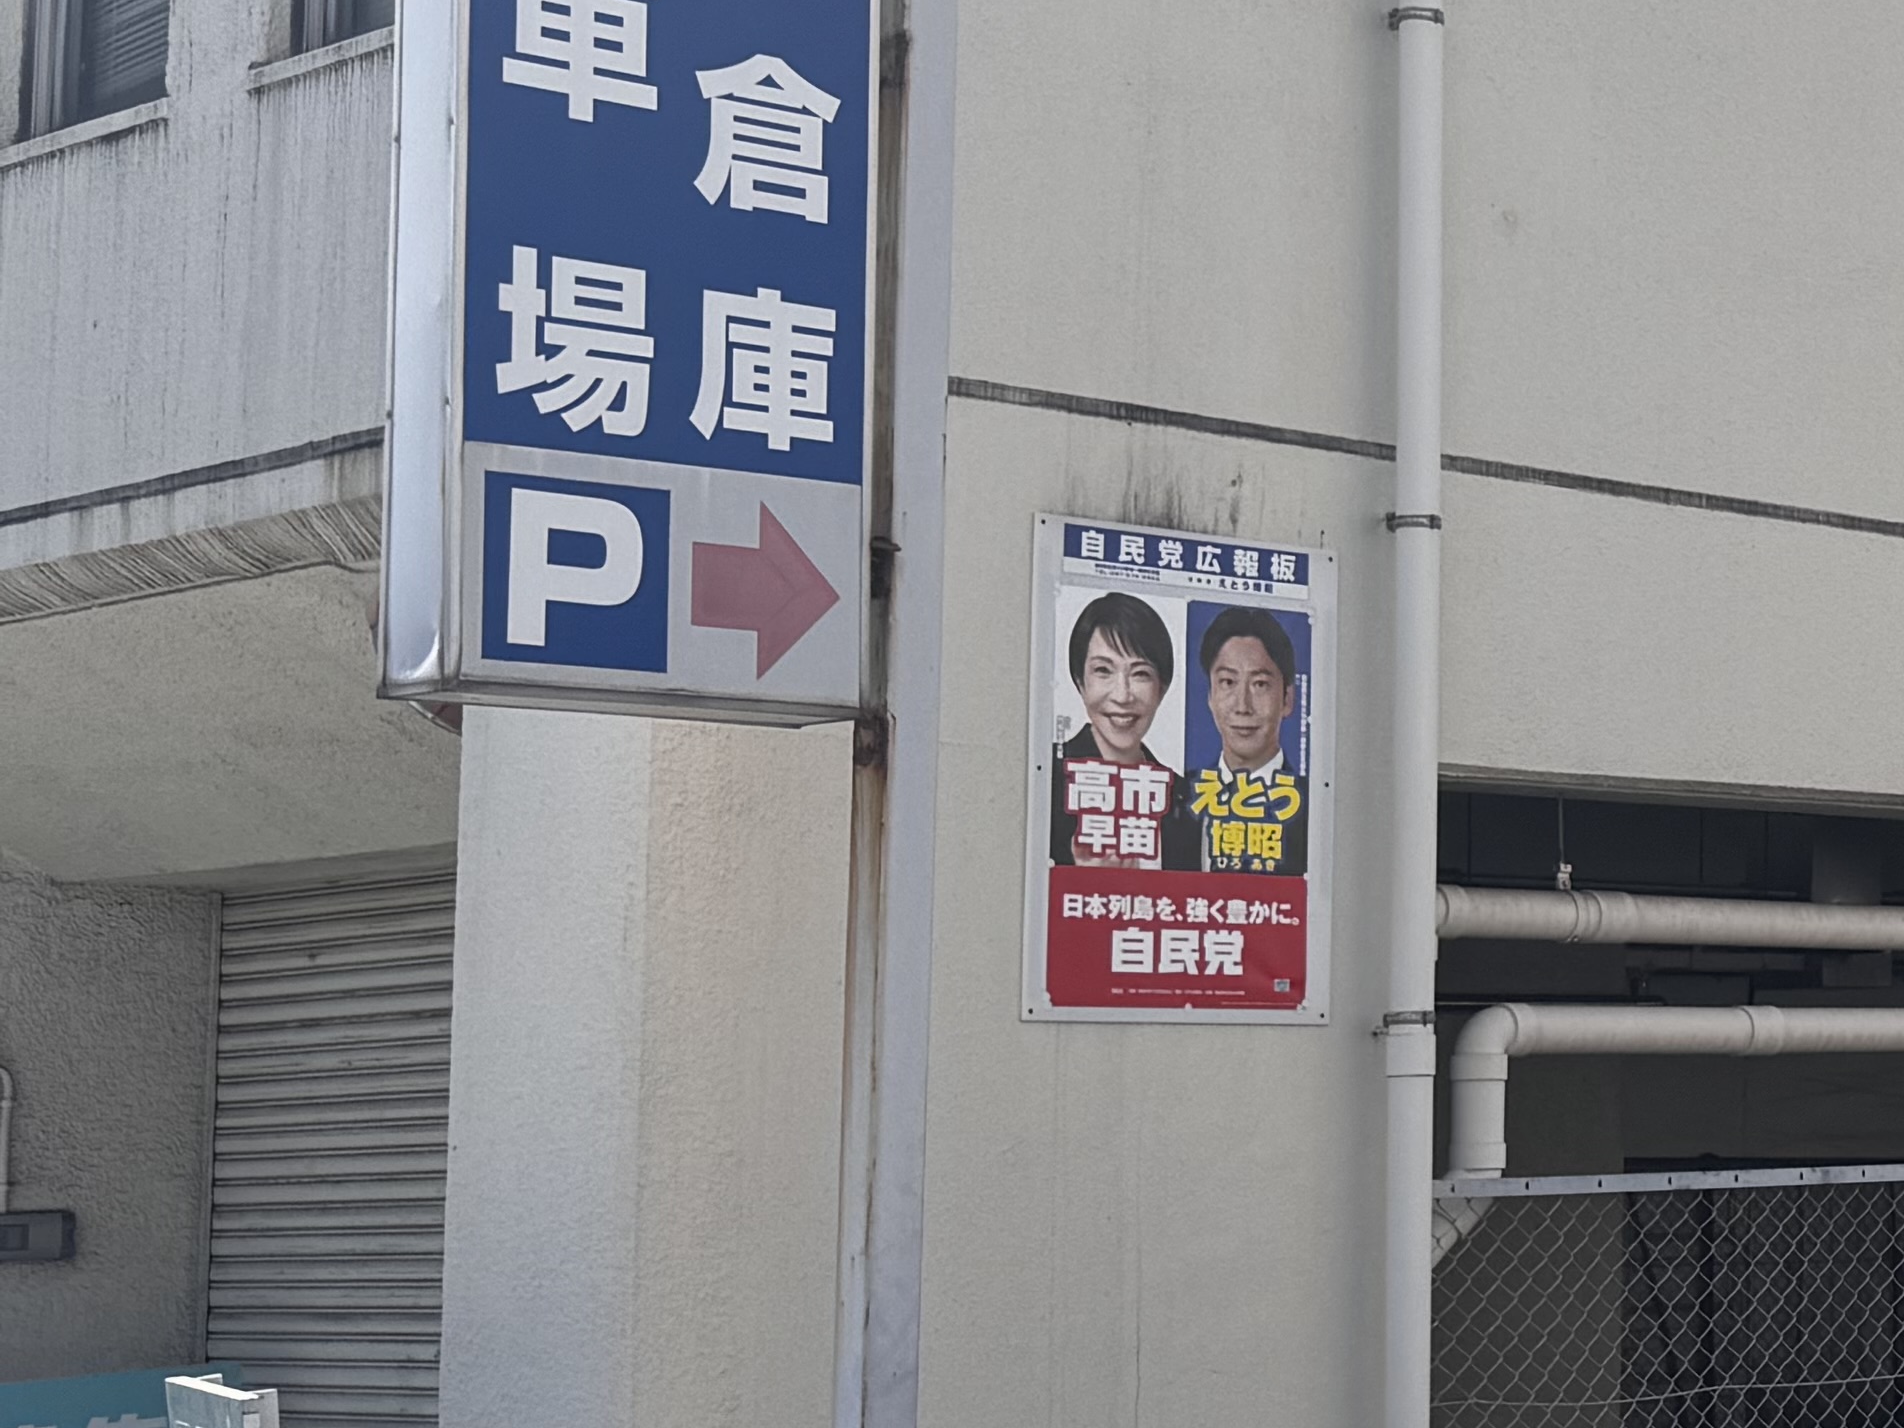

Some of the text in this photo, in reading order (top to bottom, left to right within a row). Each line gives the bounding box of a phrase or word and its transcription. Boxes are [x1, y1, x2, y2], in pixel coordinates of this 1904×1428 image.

[505, 486, 645, 648] P
[1080, 530, 1297, 582] 自民党広報板
[1067, 760, 1170, 814] 高市
[1191, 769, 1300, 821] えとう
[1078, 814, 1158, 856] 早苗
[1211, 820, 1283, 859] 博昭
[1063, 893, 1300, 926] 日本列島を、強く豊かに。
[1111, 927, 1244, 976] 自民党
